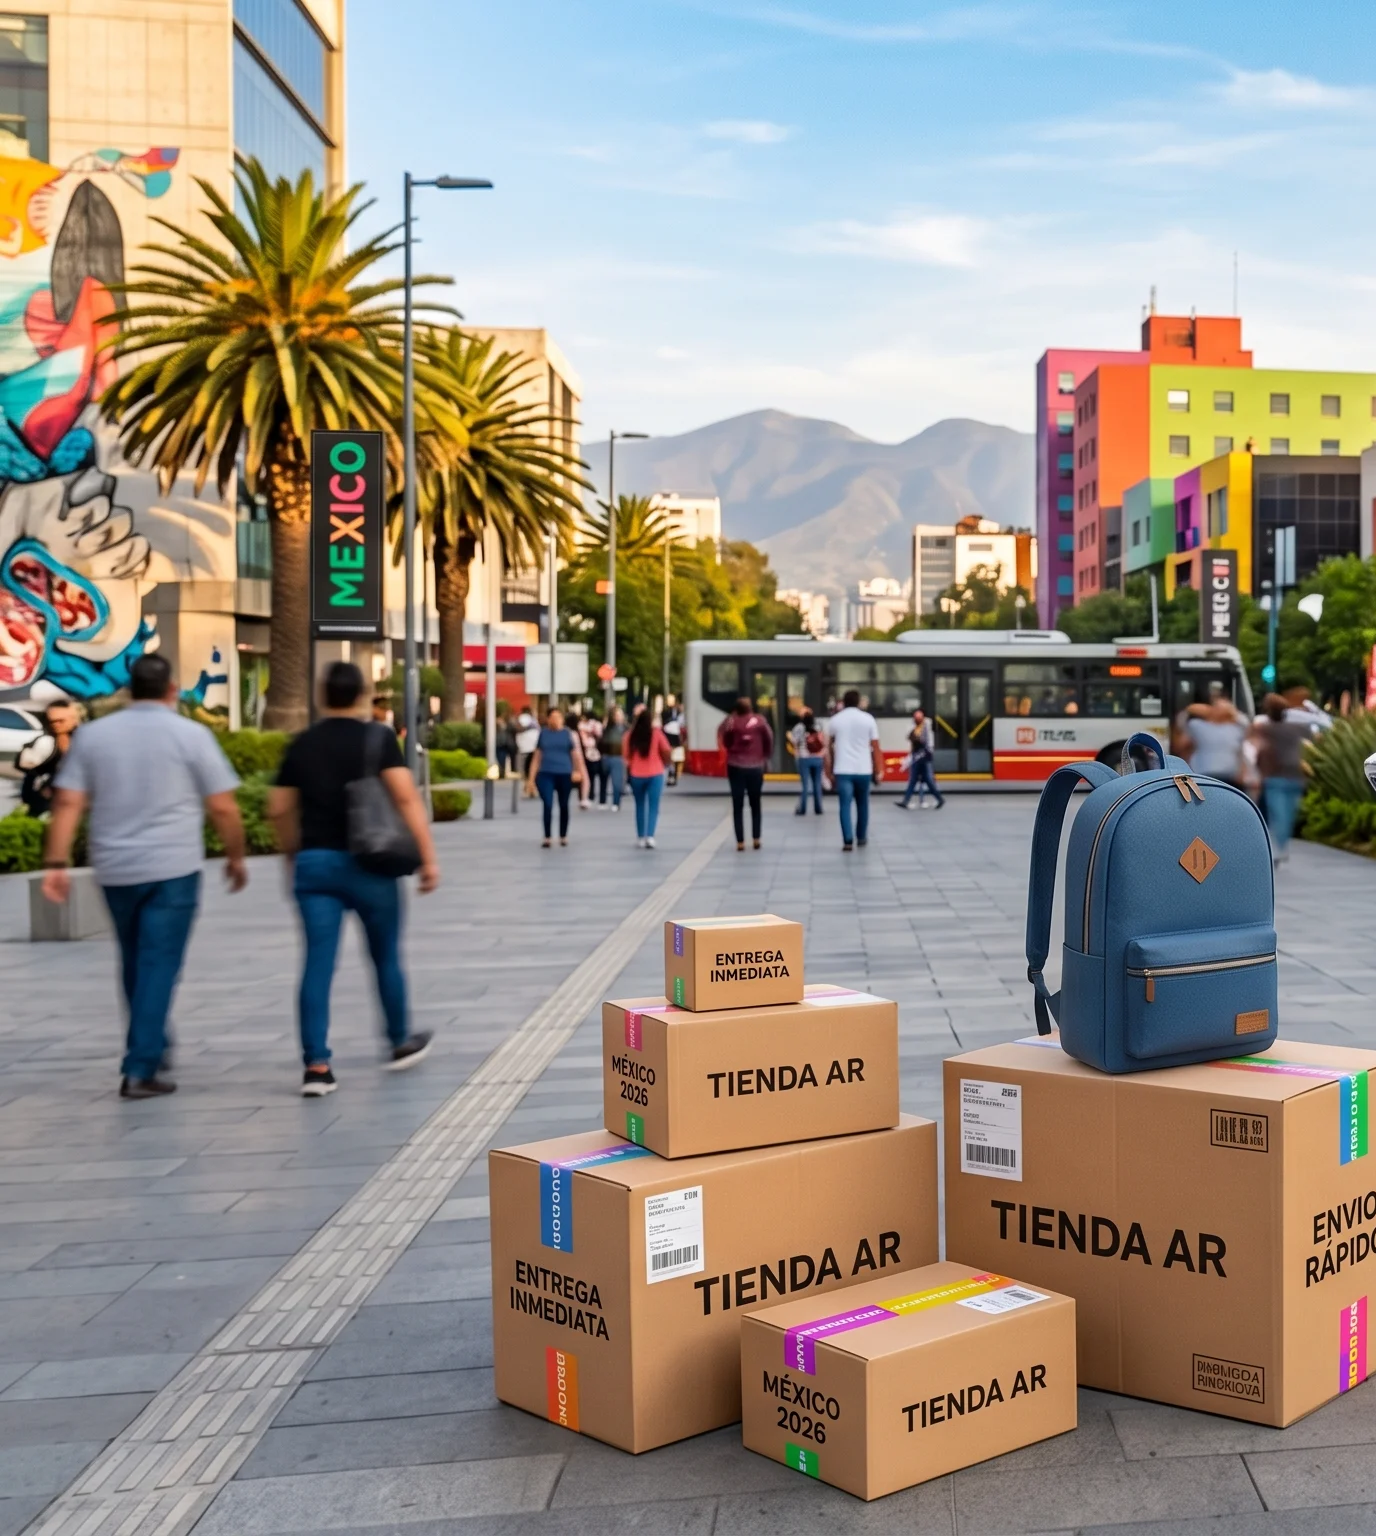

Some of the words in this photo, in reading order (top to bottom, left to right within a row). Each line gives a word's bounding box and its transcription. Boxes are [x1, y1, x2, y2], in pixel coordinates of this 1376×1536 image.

[329, 441, 367, 607] MEXICO
[710, 965, 790, 983] INMEDIATA
[715, 950, 784, 966] ENTREGA
[612, 1053, 656, 1086] MÉXICO
[620, 1081, 648, 1107] 2026
[707, 1064, 819, 1098] TIENDA
[825, 1057, 865, 1085] AR
[991, 1200, 1153, 1266] TIENDA
[1162, 1228, 1228, 1279] AR
[515, 1260, 603, 1309] ENTREGA
[694, 1247, 842, 1316] TIENDA
[851, 1230, 901, 1276] AR
[510, 1287, 610, 1341] INMEDIATA
[763, 1370, 841, 1421] MÉXICO
[901, 1377, 1004, 1433] TIENDA
[1010, 1364, 1047, 1400] AR
[777, 1406, 826, 1444] 2026
